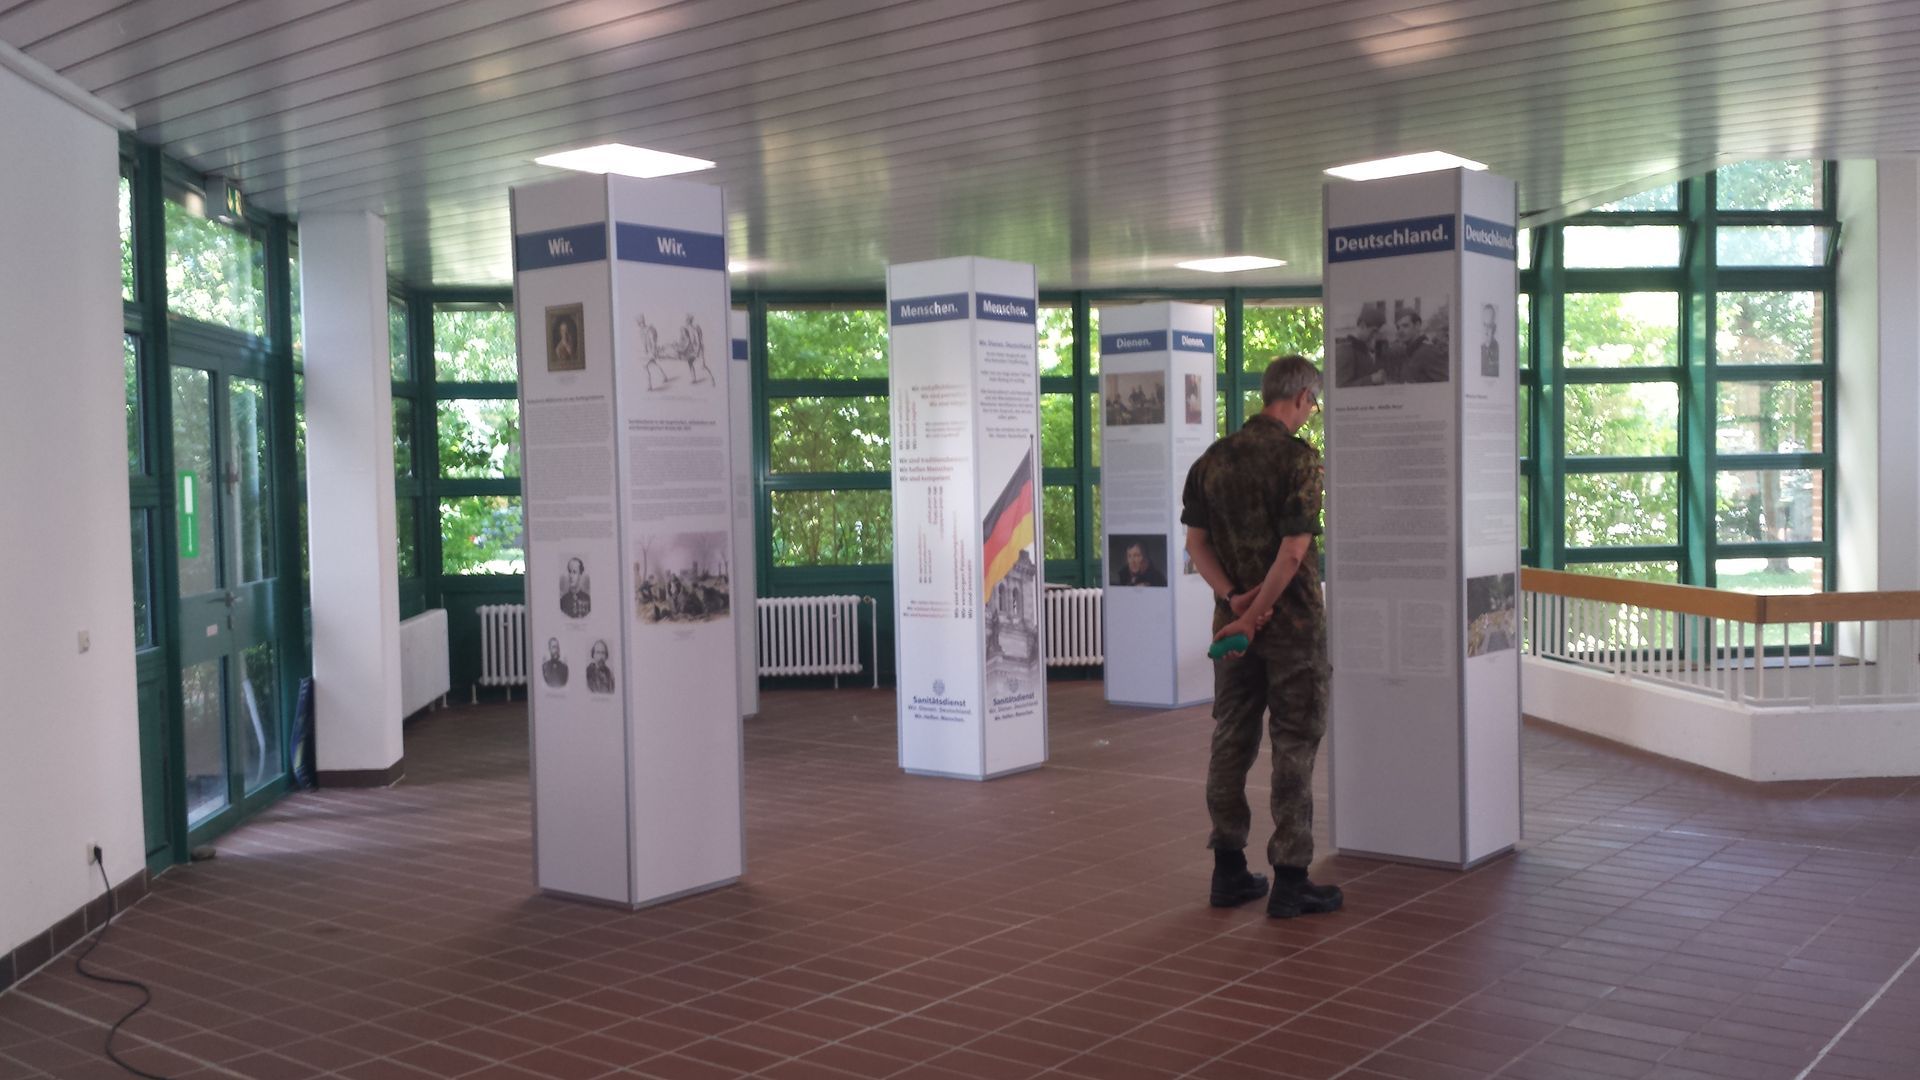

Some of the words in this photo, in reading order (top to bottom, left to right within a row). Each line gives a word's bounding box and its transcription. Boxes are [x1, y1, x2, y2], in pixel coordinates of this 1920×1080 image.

[1335, 223, 1449, 253] Deutschland.
[1465, 224, 1514, 250] Deutschland.
[548, 237, 574, 257] Wir.
[657, 236, 687, 258] Wir.
[900, 301, 958, 318] Menschen.
[983, 299, 1028, 317] Menschen.
[1116, 337, 1151, 350] Dienen.
[1181, 335, 1205, 348] Dienen.
[913, 696, 966, 707] Sanitätsdienst
[992, 692, 1035, 706] Sanitätsdienst
